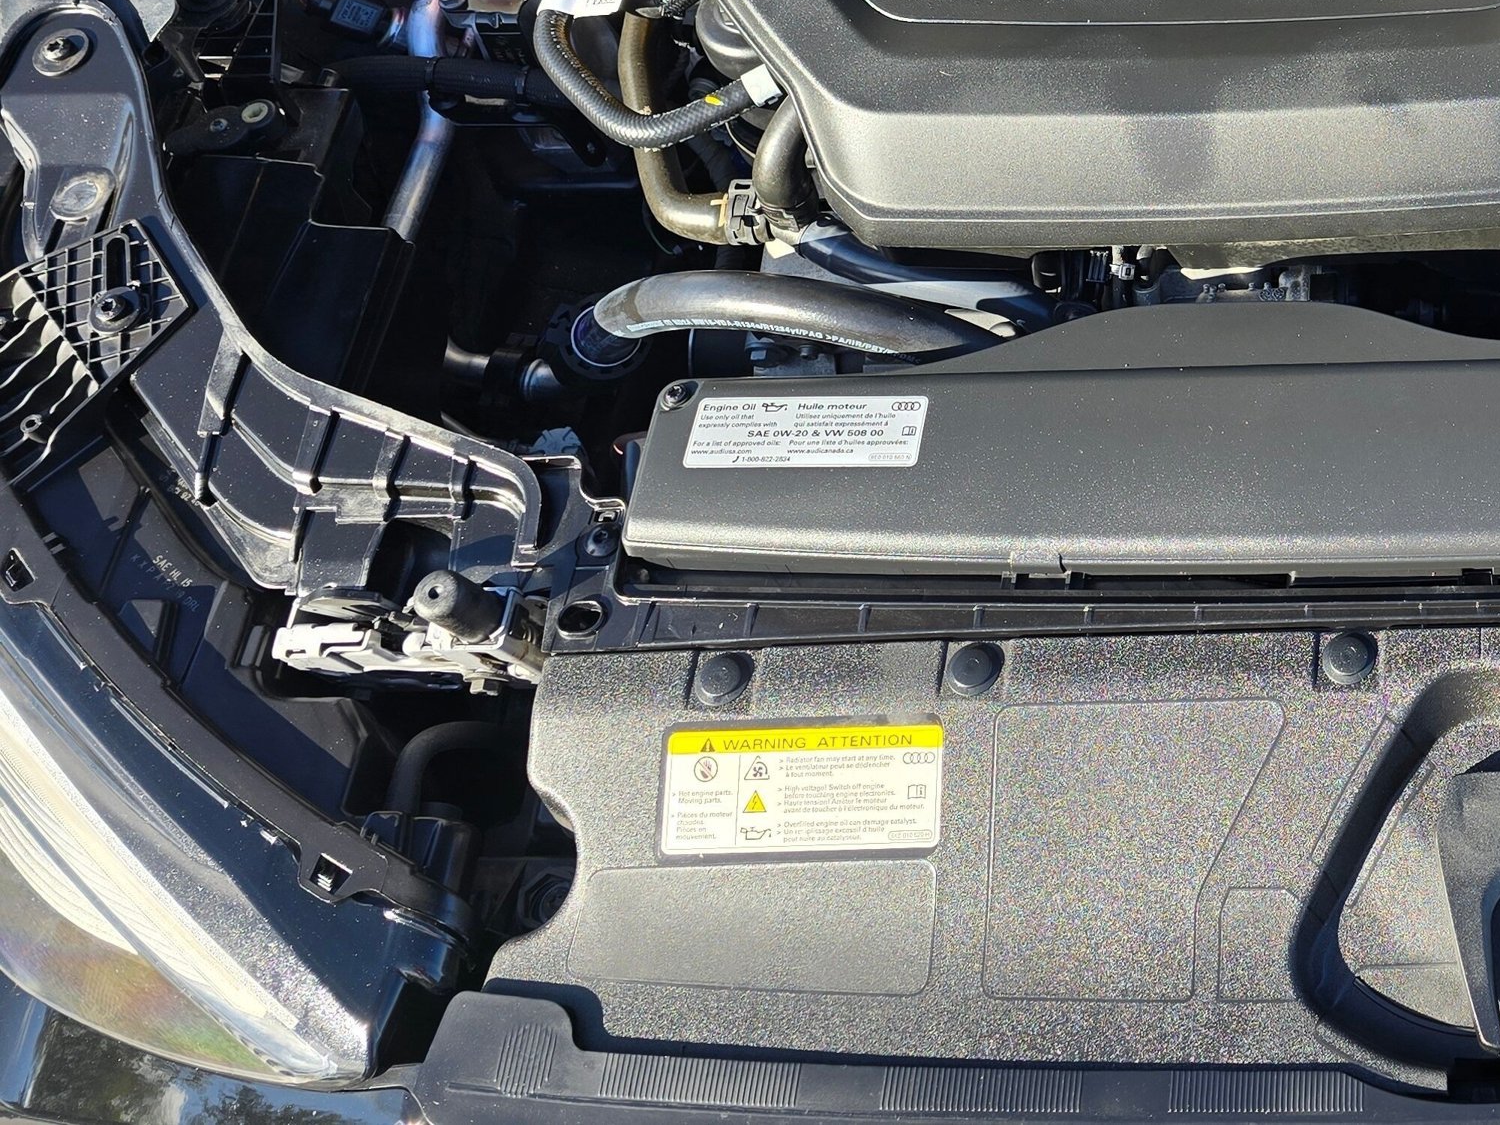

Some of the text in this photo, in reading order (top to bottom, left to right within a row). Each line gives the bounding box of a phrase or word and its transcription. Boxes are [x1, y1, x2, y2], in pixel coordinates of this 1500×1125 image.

[703, 403, 756, 412] Engine Oil
[773, 429, 808, 437] 0W-20
[152, 555, 193, 587] SAE HL 15
[723, 734, 913, 751] WARNING ATTENTION
